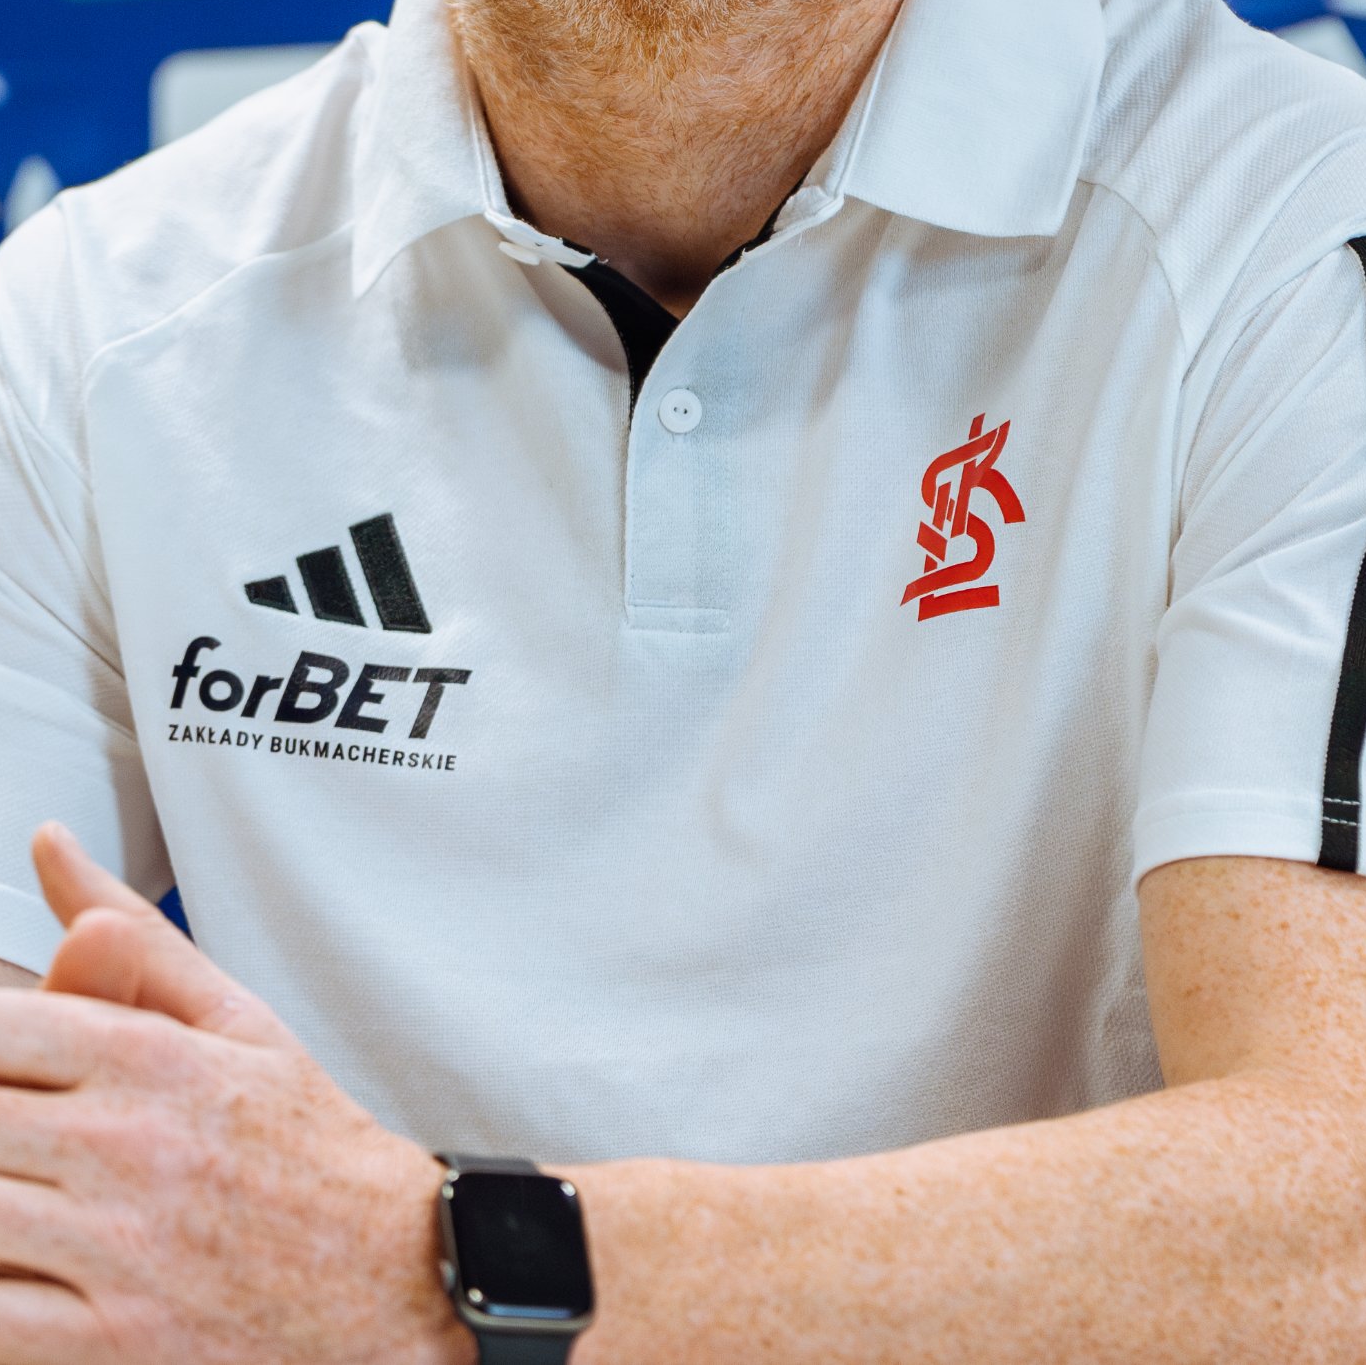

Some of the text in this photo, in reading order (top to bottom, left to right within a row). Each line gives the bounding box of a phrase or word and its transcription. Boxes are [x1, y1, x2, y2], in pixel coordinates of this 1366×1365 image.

[169, 635, 474, 740] forBET
[168, 724, 459, 772] ZAKŁADY BUKMACHERSKIE
